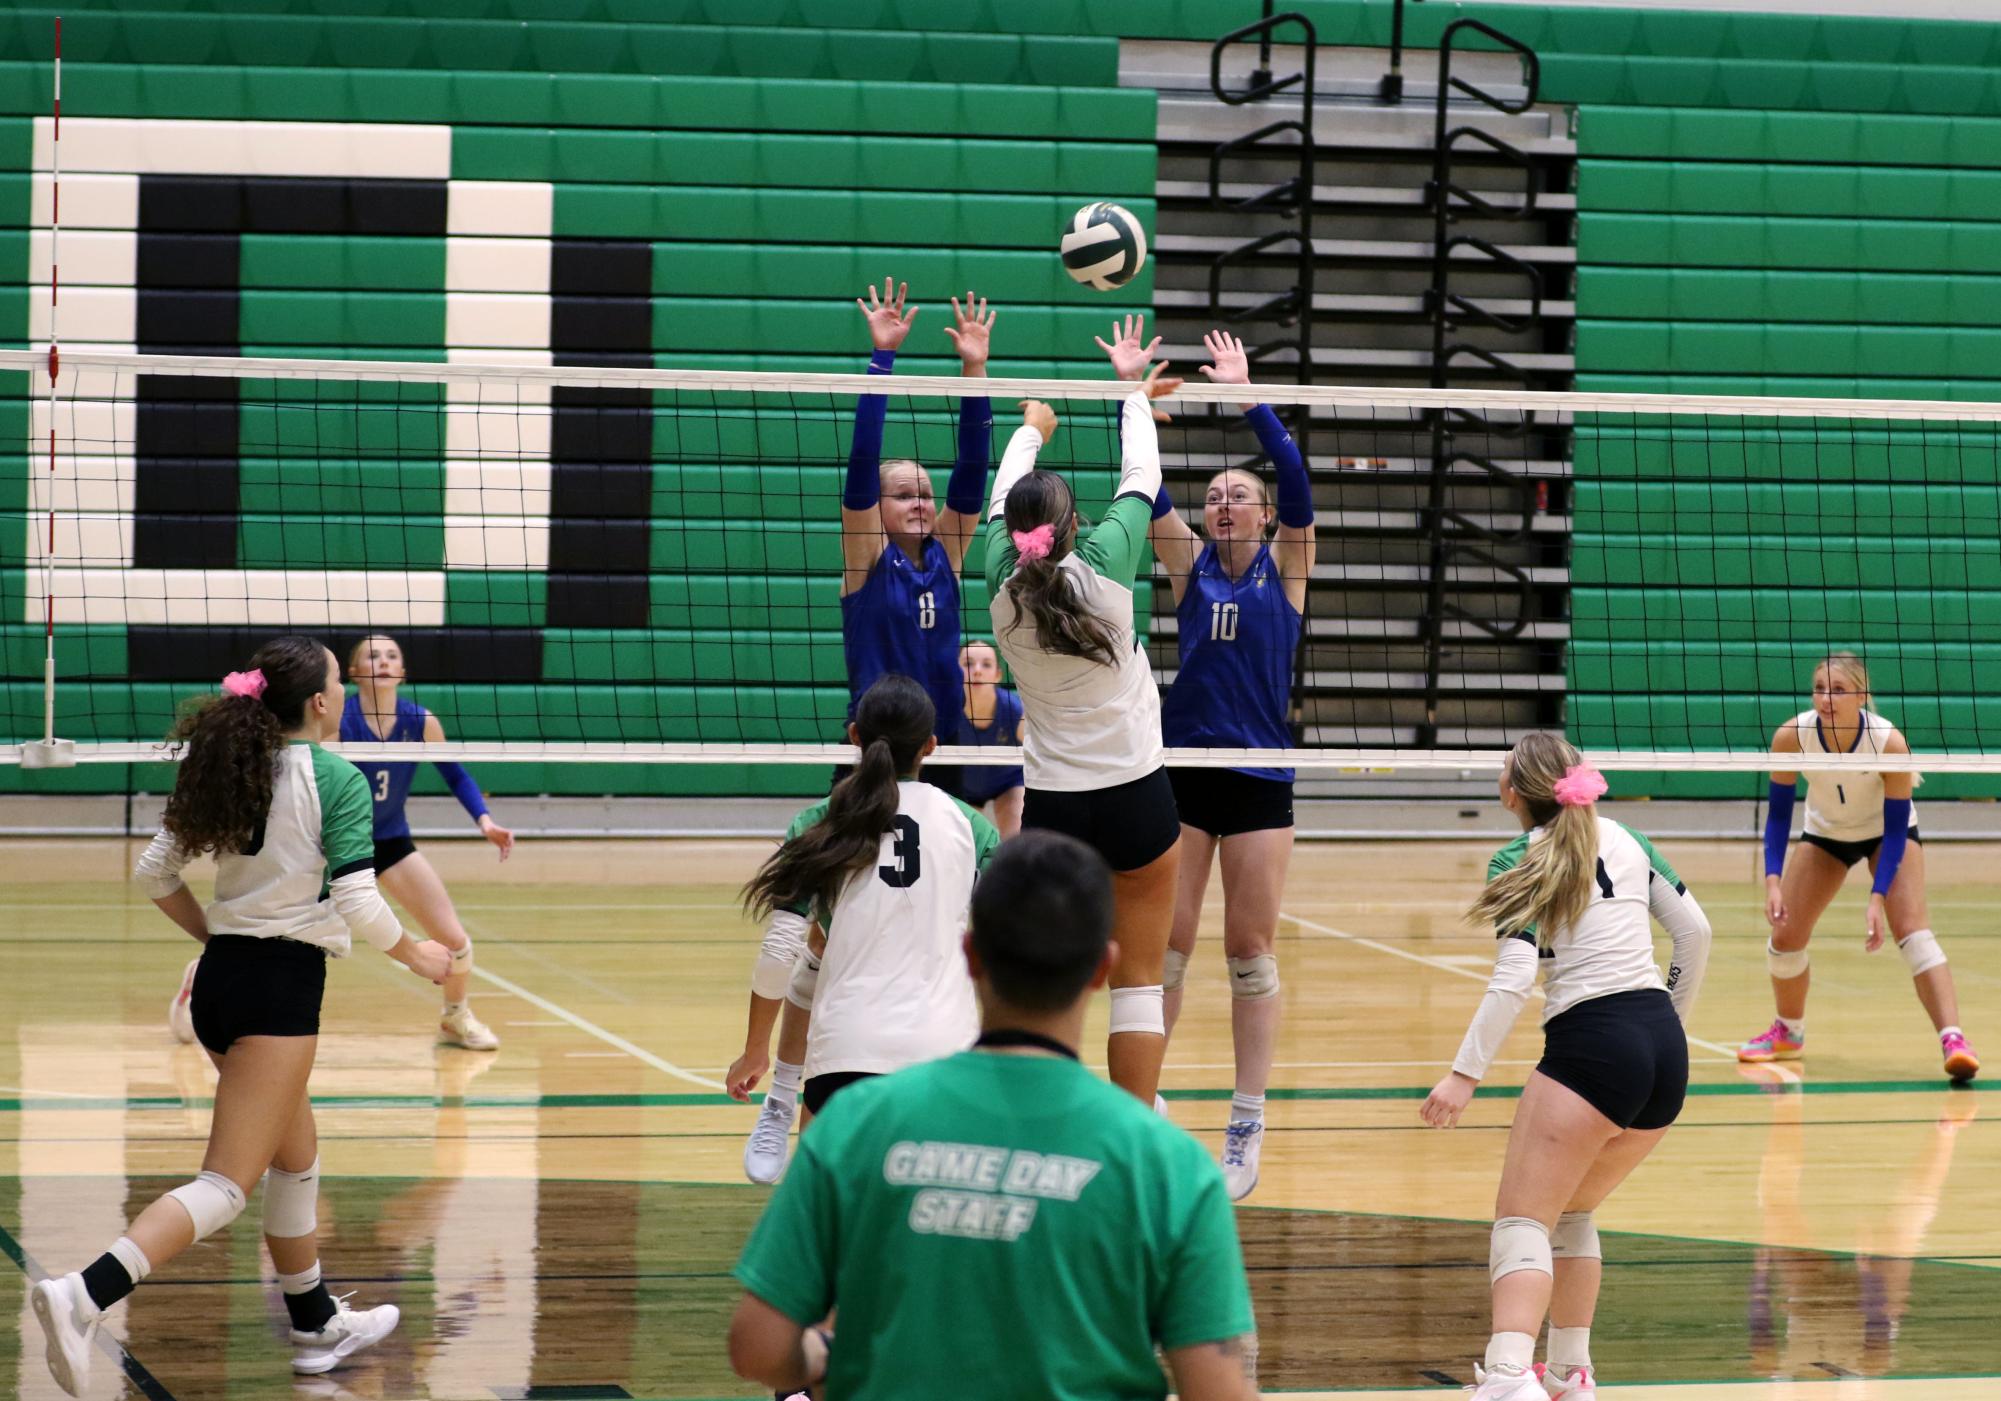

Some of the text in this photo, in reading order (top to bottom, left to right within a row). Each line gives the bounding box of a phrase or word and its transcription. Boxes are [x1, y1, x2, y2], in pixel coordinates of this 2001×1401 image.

[919, 591, 936, 629] 8
[1210, 602, 1239, 641] 10
[374, 769, 390, 801] 3
[1836, 784, 1846, 804] 1
[879, 814, 920, 887] 3
[883, 1140, 1102, 1202] GAME DAY
[908, 1188, 1039, 1242] STAFF
